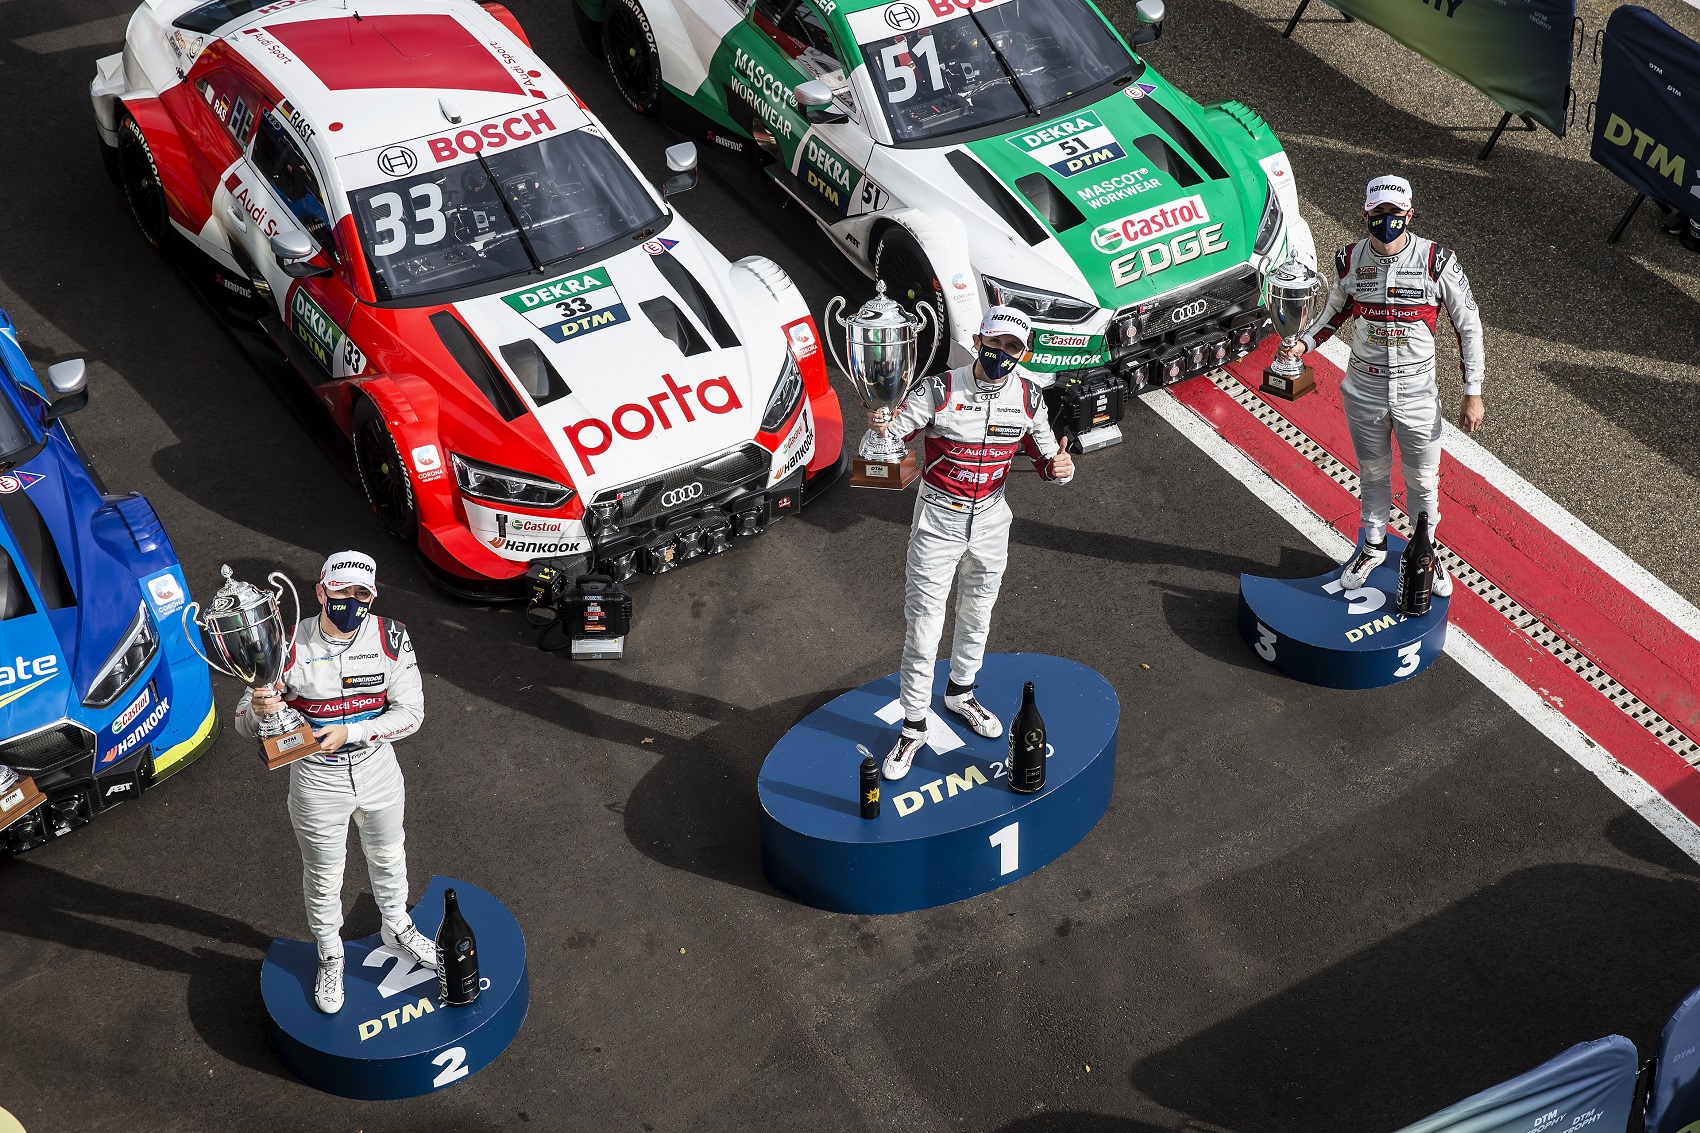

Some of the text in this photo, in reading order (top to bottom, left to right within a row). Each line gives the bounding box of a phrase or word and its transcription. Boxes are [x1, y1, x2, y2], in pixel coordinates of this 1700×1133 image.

[1528, 14, 1552, 31] TROPHY
[1534, 11, 1548, 22] DTM
[252, 32, 293, 64] Audi Sport
[490, 41, 536, 87] Audi Sport
[880, 34, 947, 104] 51
[1649, 62, 1663, 75] DTM
[1667, 85, 1681, 97] DTM
[731, 76, 791, 140] WORKWEAR
[291, 110, 316, 143] RAST
[427, 109, 557, 164] BOSCH
[1025, 117, 1095, 148] DEKRA
[1058, 137, 1090, 156] 51
[1066, 148, 1113, 173] DTM
[1603, 112, 1686, 187] DTM
[808, 140, 851, 192] DEKRA
[807, 168, 840, 208] DTM
[861, 180, 881, 212] 51
[1087, 178, 1163, 210] WORKWEAR
[237, 188, 268, 227] Audi
[369, 182, 447, 257] 33
[1120, 199, 1204, 243] Castrol
[1390, 219, 1404, 230] #3
[1109, 221, 1230, 289] EDGE
[519, 274, 603, 308] DEKRA
[295, 297, 335, 351] DEKRA
[556, 297, 592, 319] 33
[560, 311, 616, 337] DTM
[1368, 307, 1419, 319] Audi Sport
[298, 322, 328, 367] DTM
[1050, 334, 1087, 347] Castrol
[1376, 327, 1405, 337] Castrol
[344, 339, 362, 375] 33
[562, 373, 743, 477] porta
[964, 448, 1012, 458] Audi Sport
[418, 469, 443, 480] CORONA
[523, 519, 562, 533] Castrol
[1254, 622, 1277, 662] 3
[1344, 614, 1398, 643] DTM
[1393, 640, 1423, 677] 3
[121, 692, 149, 726] Castrol
[322, 697, 384, 712] Audi Sport
[283, 736, 297, 745] DTM
[5, 792, 18, 803] DTM
[892, 764, 988, 817] DTM
[988, 822, 1019, 876] 1
[362, 944, 438, 998] 2
[358, 997, 435, 1043] DTM
[431, 1047, 469, 1088] 2
[1673, 1046, 1696, 1063] DTM
[1527, 1113, 1568, 1133] ROPHY
[1534, 1108, 1558, 1128] DTM
[1572, 1108, 1596, 1125] DTM
